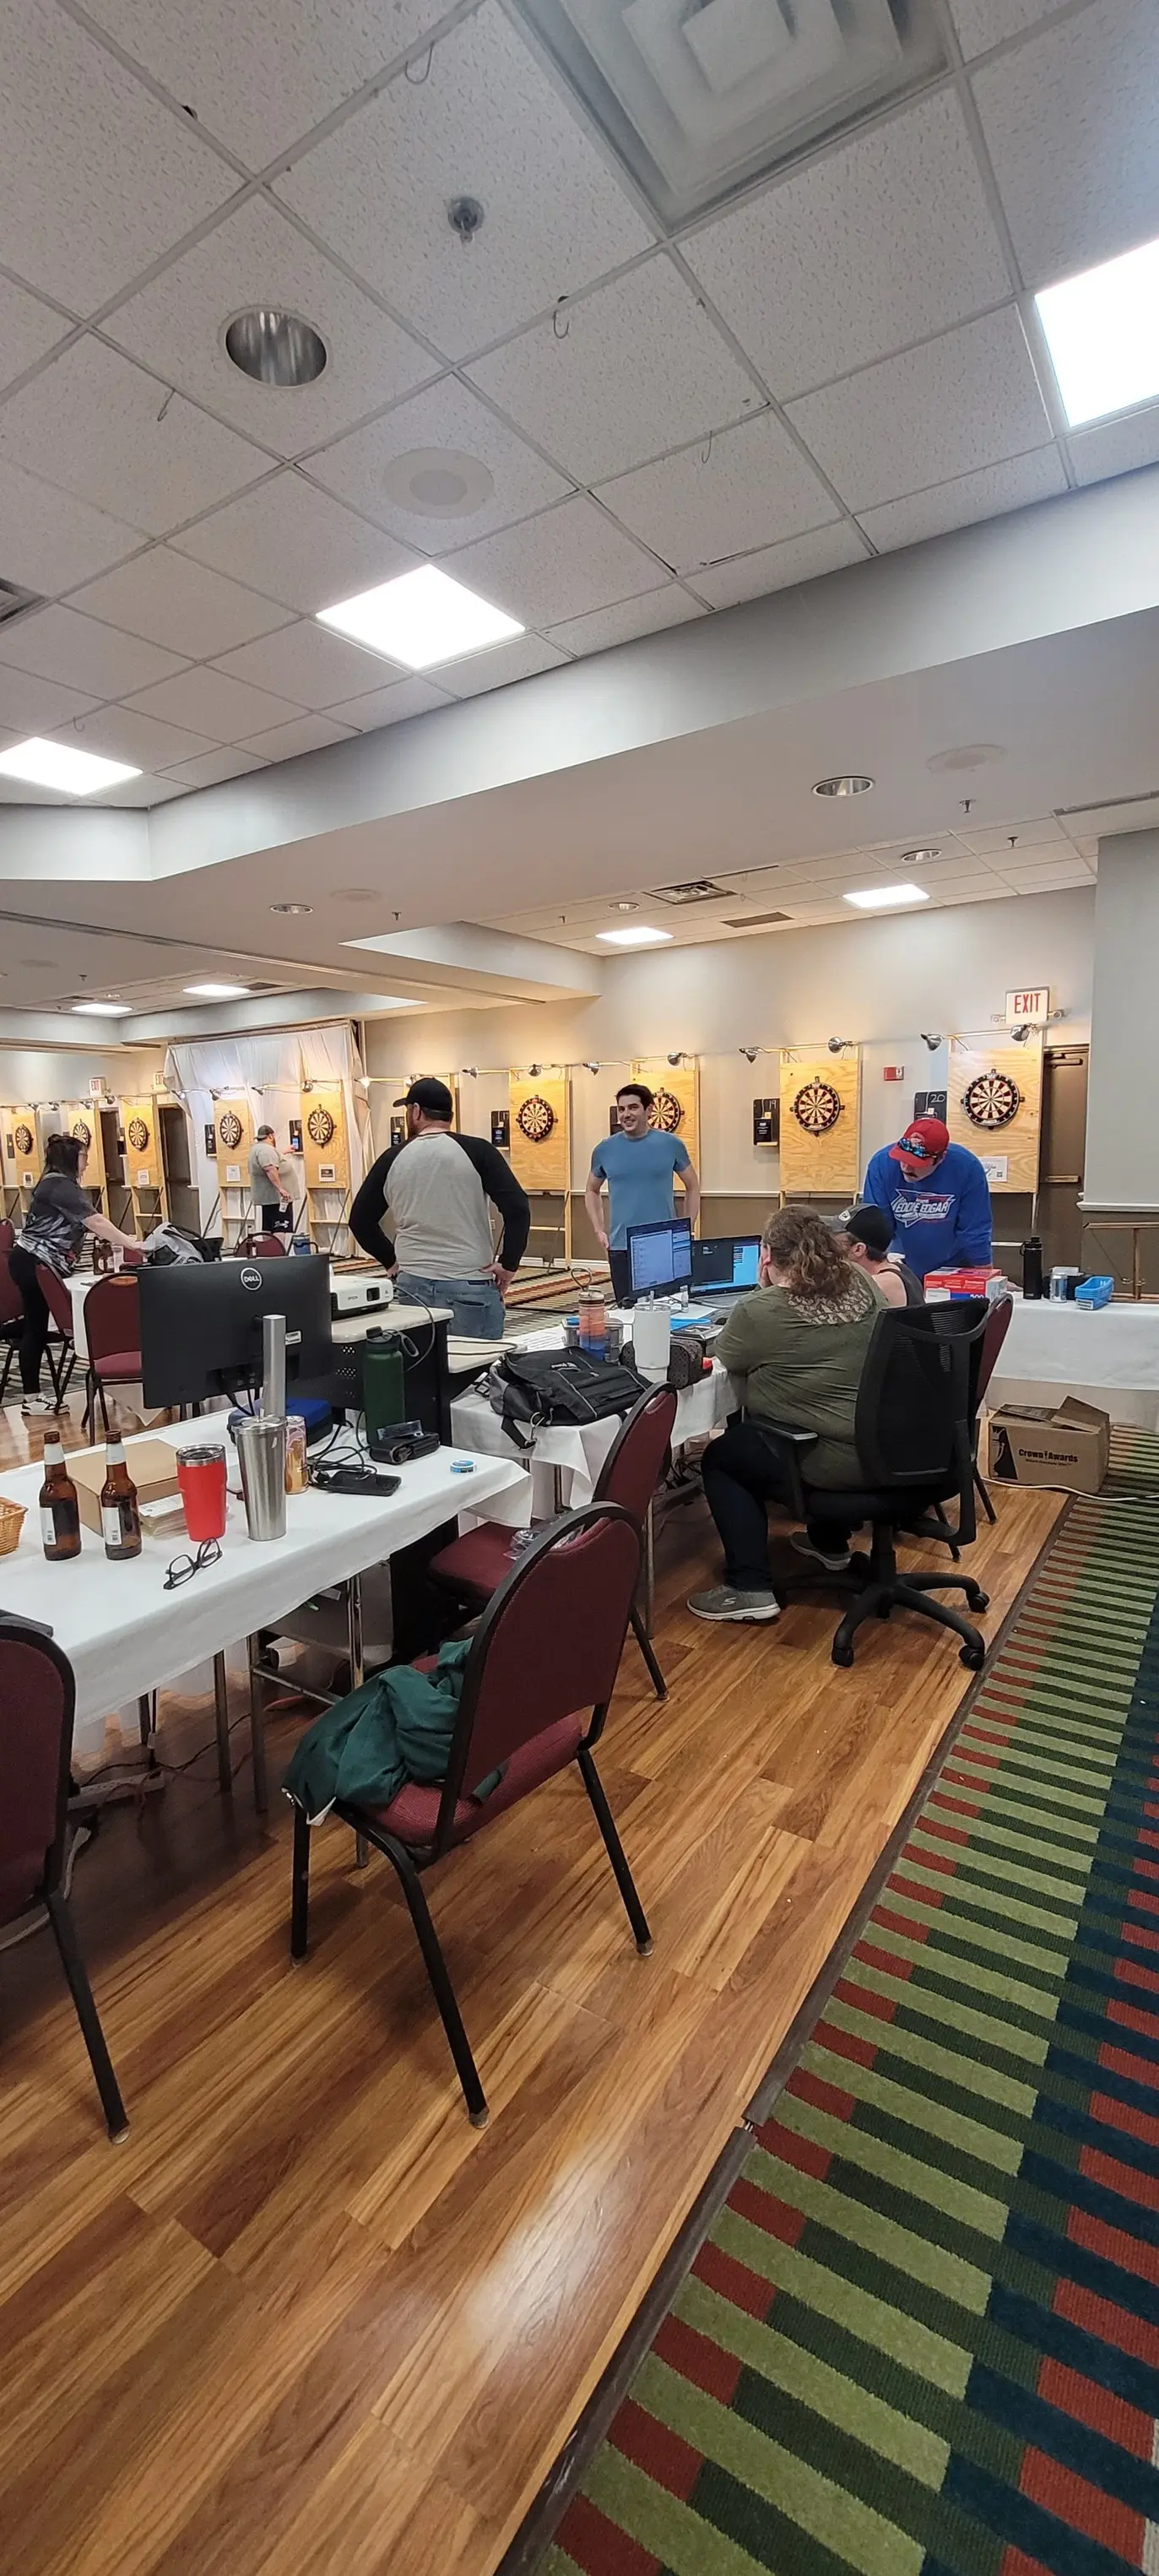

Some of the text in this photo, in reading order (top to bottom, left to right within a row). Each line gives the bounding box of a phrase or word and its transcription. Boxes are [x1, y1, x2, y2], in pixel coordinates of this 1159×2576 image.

[1015, 993, 1041, 1014] EXIT
[930, 1093, 945, 1103] 20
[769, 1099, 777, 1110] 19
[895, 1201, 948, 1213] EDDIE EDGAR
[1018, 1449, 1043, 1458] Crown
[1048, 1451, 1079, 1463] Awards
